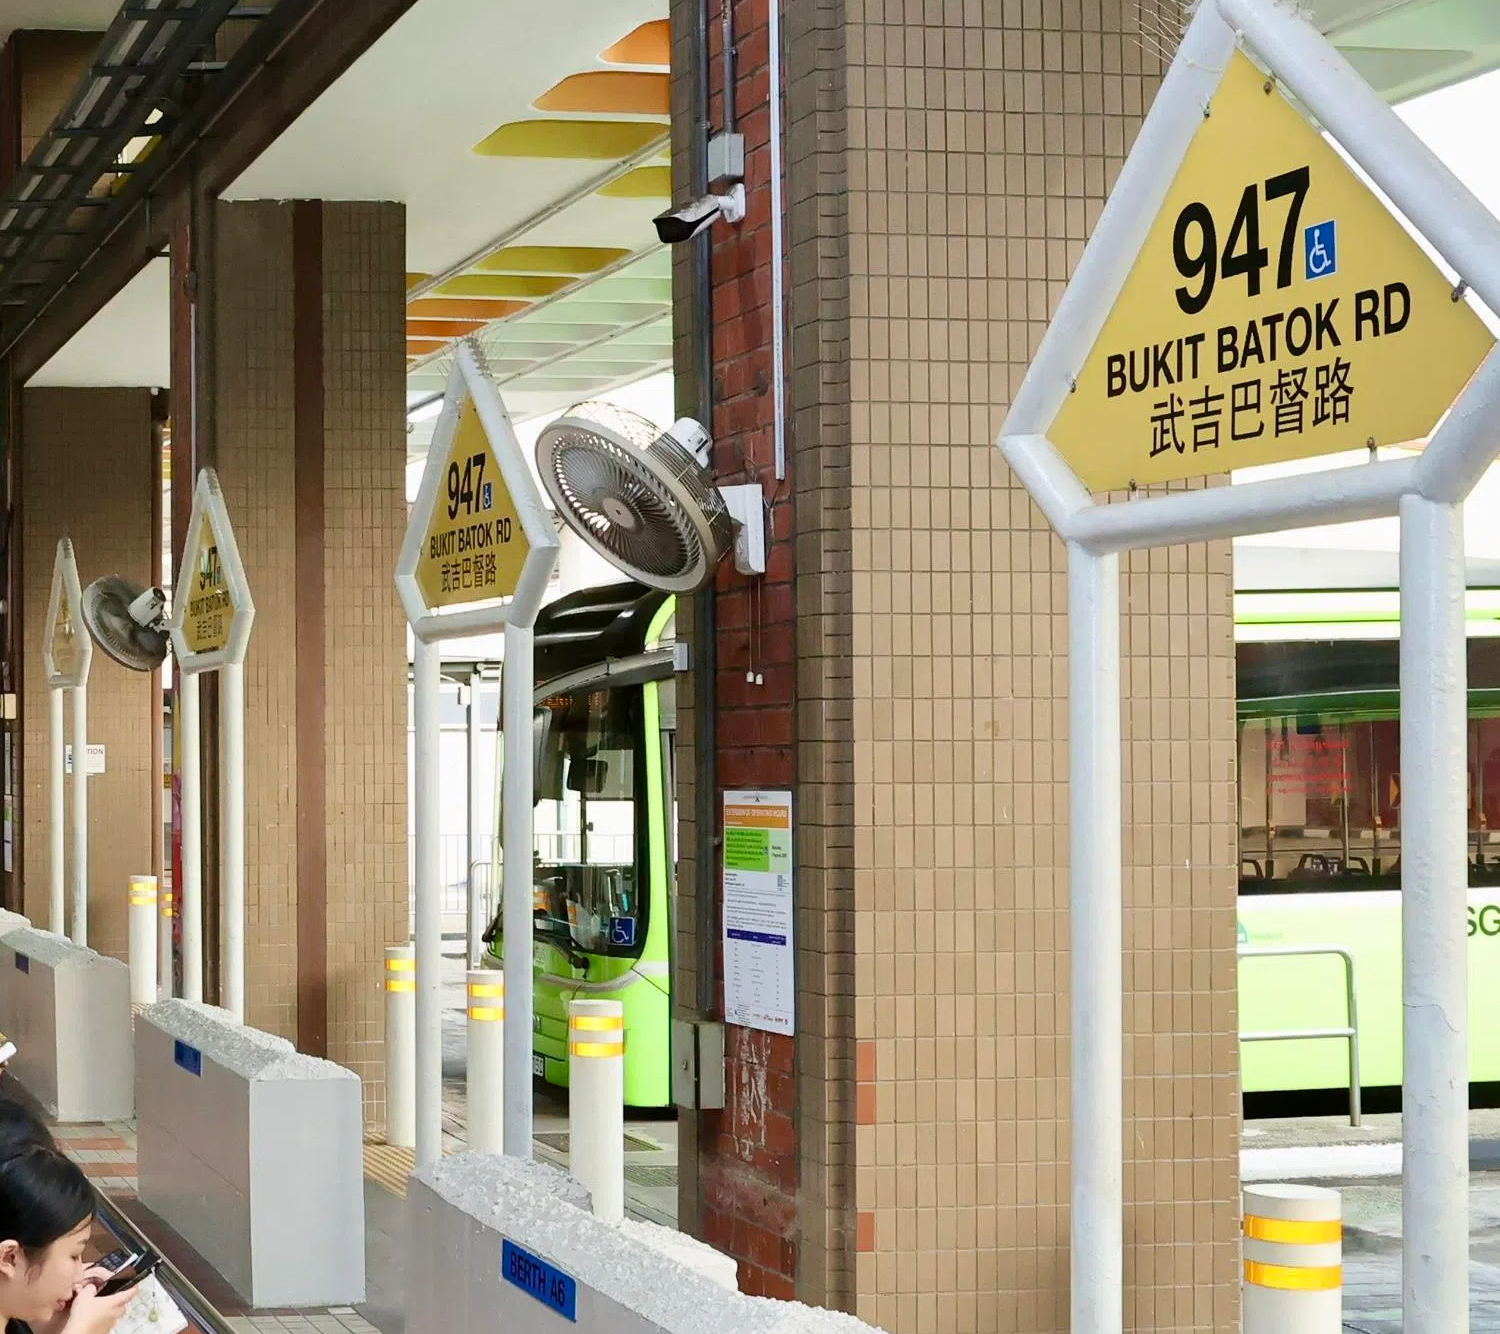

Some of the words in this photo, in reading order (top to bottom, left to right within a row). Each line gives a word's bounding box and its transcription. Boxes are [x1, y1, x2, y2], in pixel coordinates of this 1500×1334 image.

[1172, 165, 1310, 315] 947
[1106, 332, 1206, 398] BUKIT
[1216, 298, 1342, 374] BATOK
[1354, 281, 1411, 342] RD
[1149, 357, 1355, 458] 武吉巴督路
[448, 453, 486, 520] 947
[430, 531, 456, 559] BUKIT
[458, 522, 493, 552] BATOK
[496, 518, 512, 544] RD
[441, 551, 497, 593] 武吉巴督路
[510, 1250, 547, 1296] BERTH
[551, 1274, 566, 1307] A6
